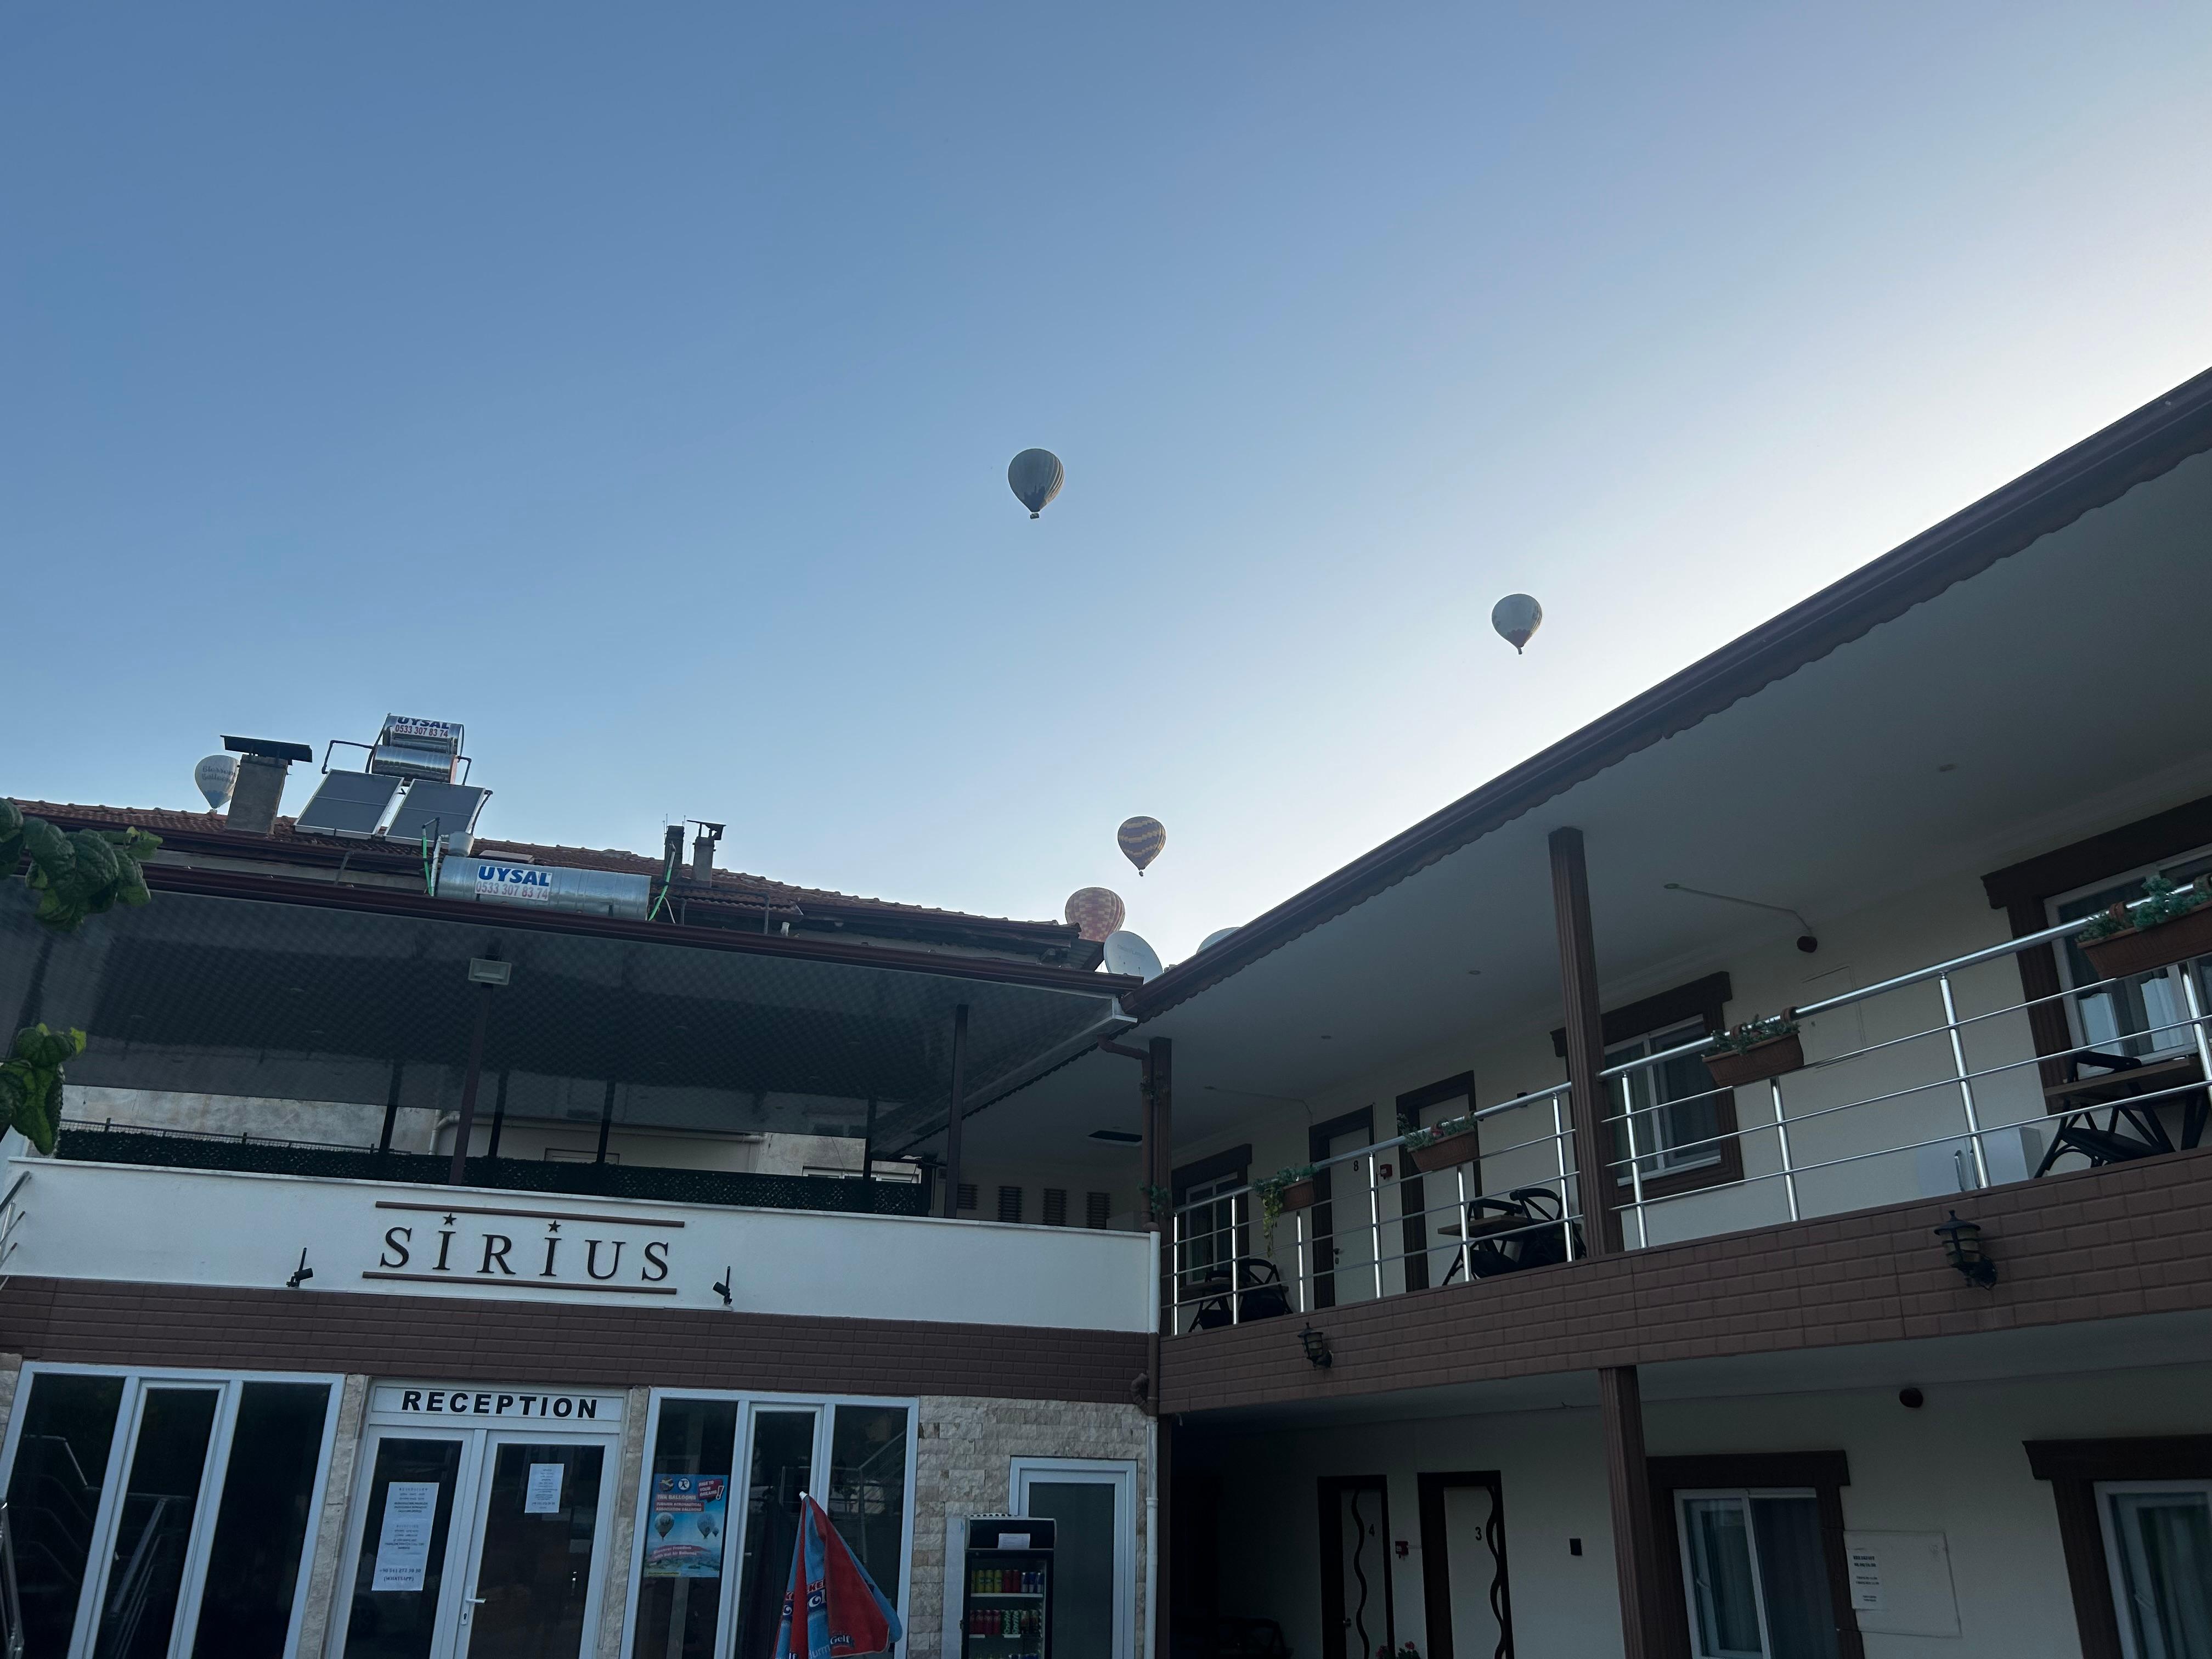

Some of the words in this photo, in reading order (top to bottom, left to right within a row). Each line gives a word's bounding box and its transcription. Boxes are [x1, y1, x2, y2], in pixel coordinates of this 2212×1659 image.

[397, 716, 449, 729] UYSAL
[396, 724, 413, 734] 0533
[414, 727, 427, 736] 307
[440, 730, 448, 738] 74
[478, 866, 550, 887] UYSAL
[476, 881, 499, 894] 0533
[502, 883, 520, 896] 307
[522, 886, 534, 898] 83
[537, 888, 548, 899] 74
[1353, 1160, 1359, 1171] 8
[402, 1391, 597, 1418] RECEPTION
[1369, 1523, 1375, 1537] 4
[1475, 1526, 1482, 1541] 3
[830, 1635, 851, 1645] Golf
